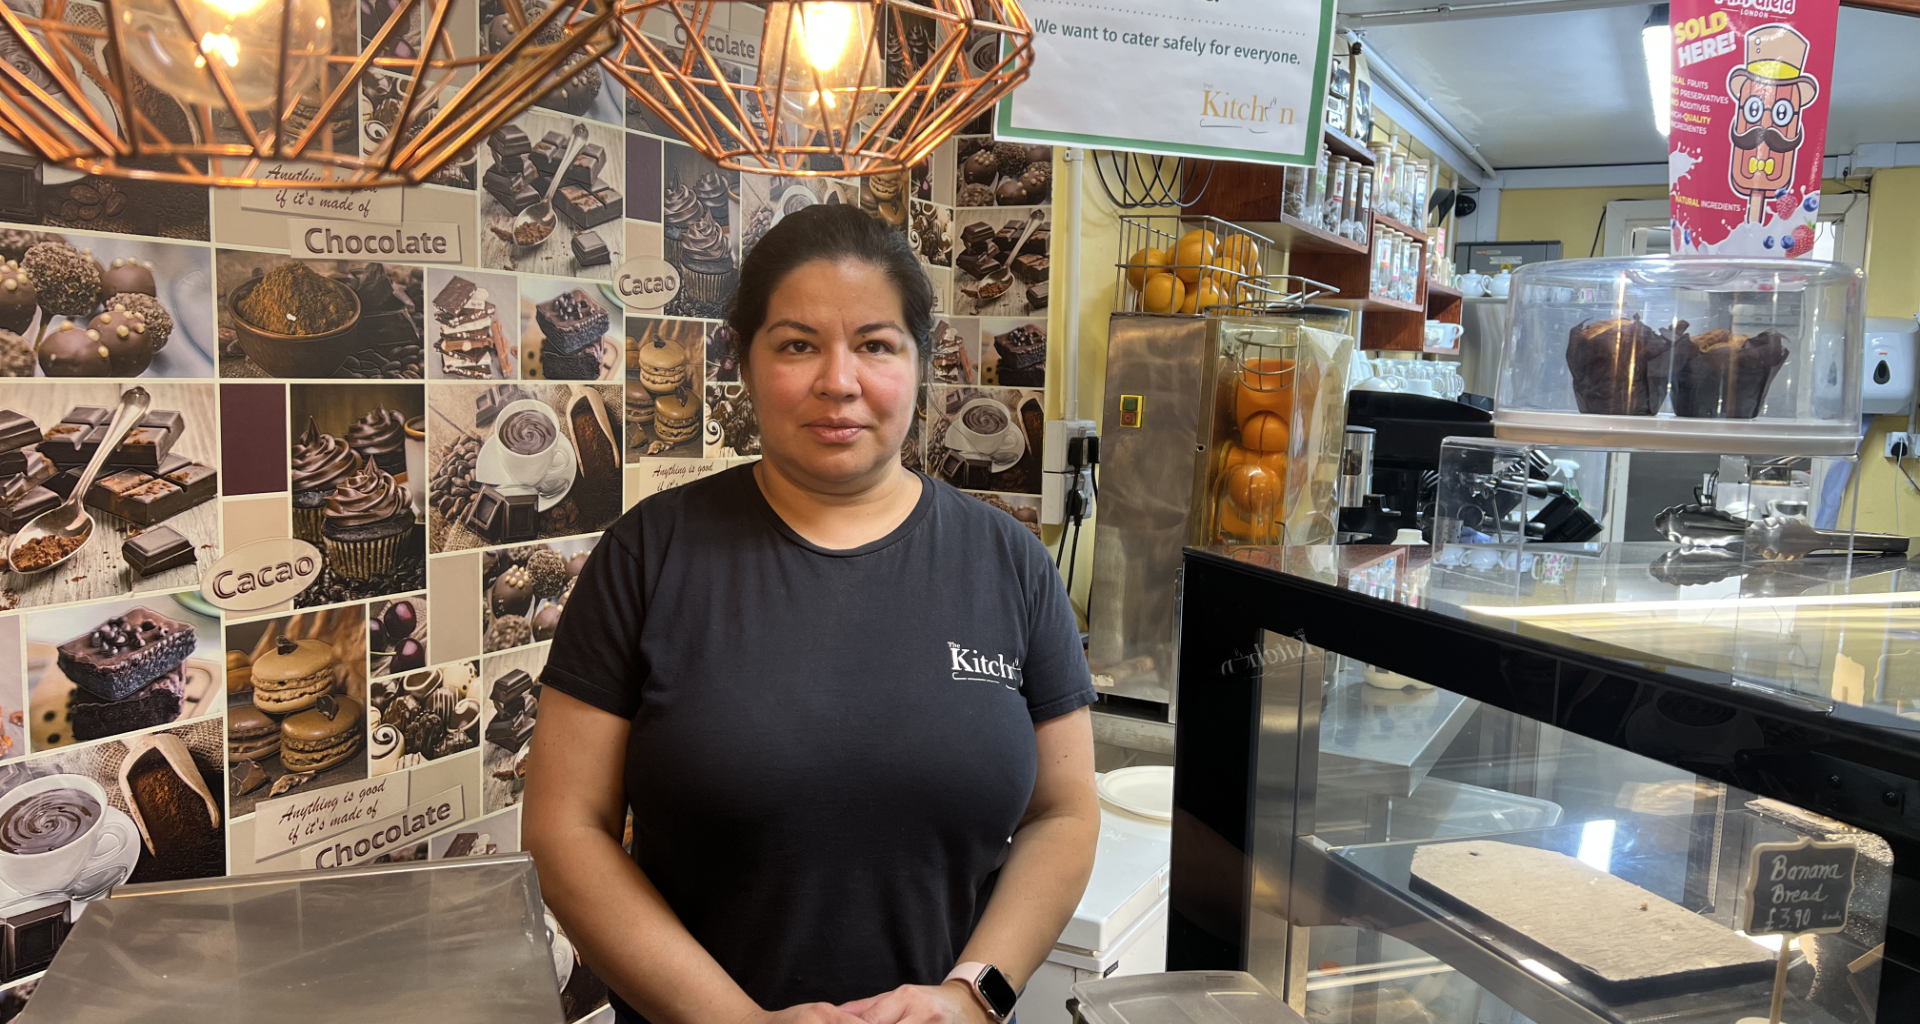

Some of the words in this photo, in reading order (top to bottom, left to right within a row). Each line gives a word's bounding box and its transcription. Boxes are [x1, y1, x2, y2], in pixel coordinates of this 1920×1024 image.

[1740, 9, 1769, 18] LONDON
[1674, 11, 1728, 44] SOLD
[674, 24, 755, 59] Ccolate
[1034, 18, 1057, 34] We
[1062, 24, 1098, 40] want
[1103, 27, 1117, 43] to
[1122, 31, 1160, 48] cater
[1163, 35, 1206, 56] safely
[1209, 39, 1231, 56] for
[1234, 47, 1301, 65] everyone.
[1677, 31, 1737, 68] HERE!
[1680, 89, 1729, 104] PRESERVATIVES
[1687, 79, 1709, 90] FRUITS
[1680, 100, 1711, 113] ADDITIVES
[276, 188, 287, 208] if
[293, 190, 315, 206] it's
[320, 197, 353, 211] made
[358, 199, 371, 218] of
[1675, 195, 1700, 207] NATURAL
[1701, 200, 1741, 212] INGREDIENTS
[304, 227, 447, 254] Chocolate
[618, 274, 676, 296] Cacao
[652, 463, 686, 478] Anything
[689, 464, 695, 474] is
[698, 461, 714, 476] good
[212, 556, 314, 599] Cacao
[279, 797, 338, 825] Anything
[343, 790, 354, 802] is
[358, 778, 387, 803] good
[288, 826, 300, 845] if
[305, 817, 325, 836] it's
[330, 806, 362, 826] made
[366, 800, 379, 819] of
[315, 802, 451, 870] Chocolate
[1770, 855, 1846, 881] Banana
[1771, 883, 1829, 904] Bread
